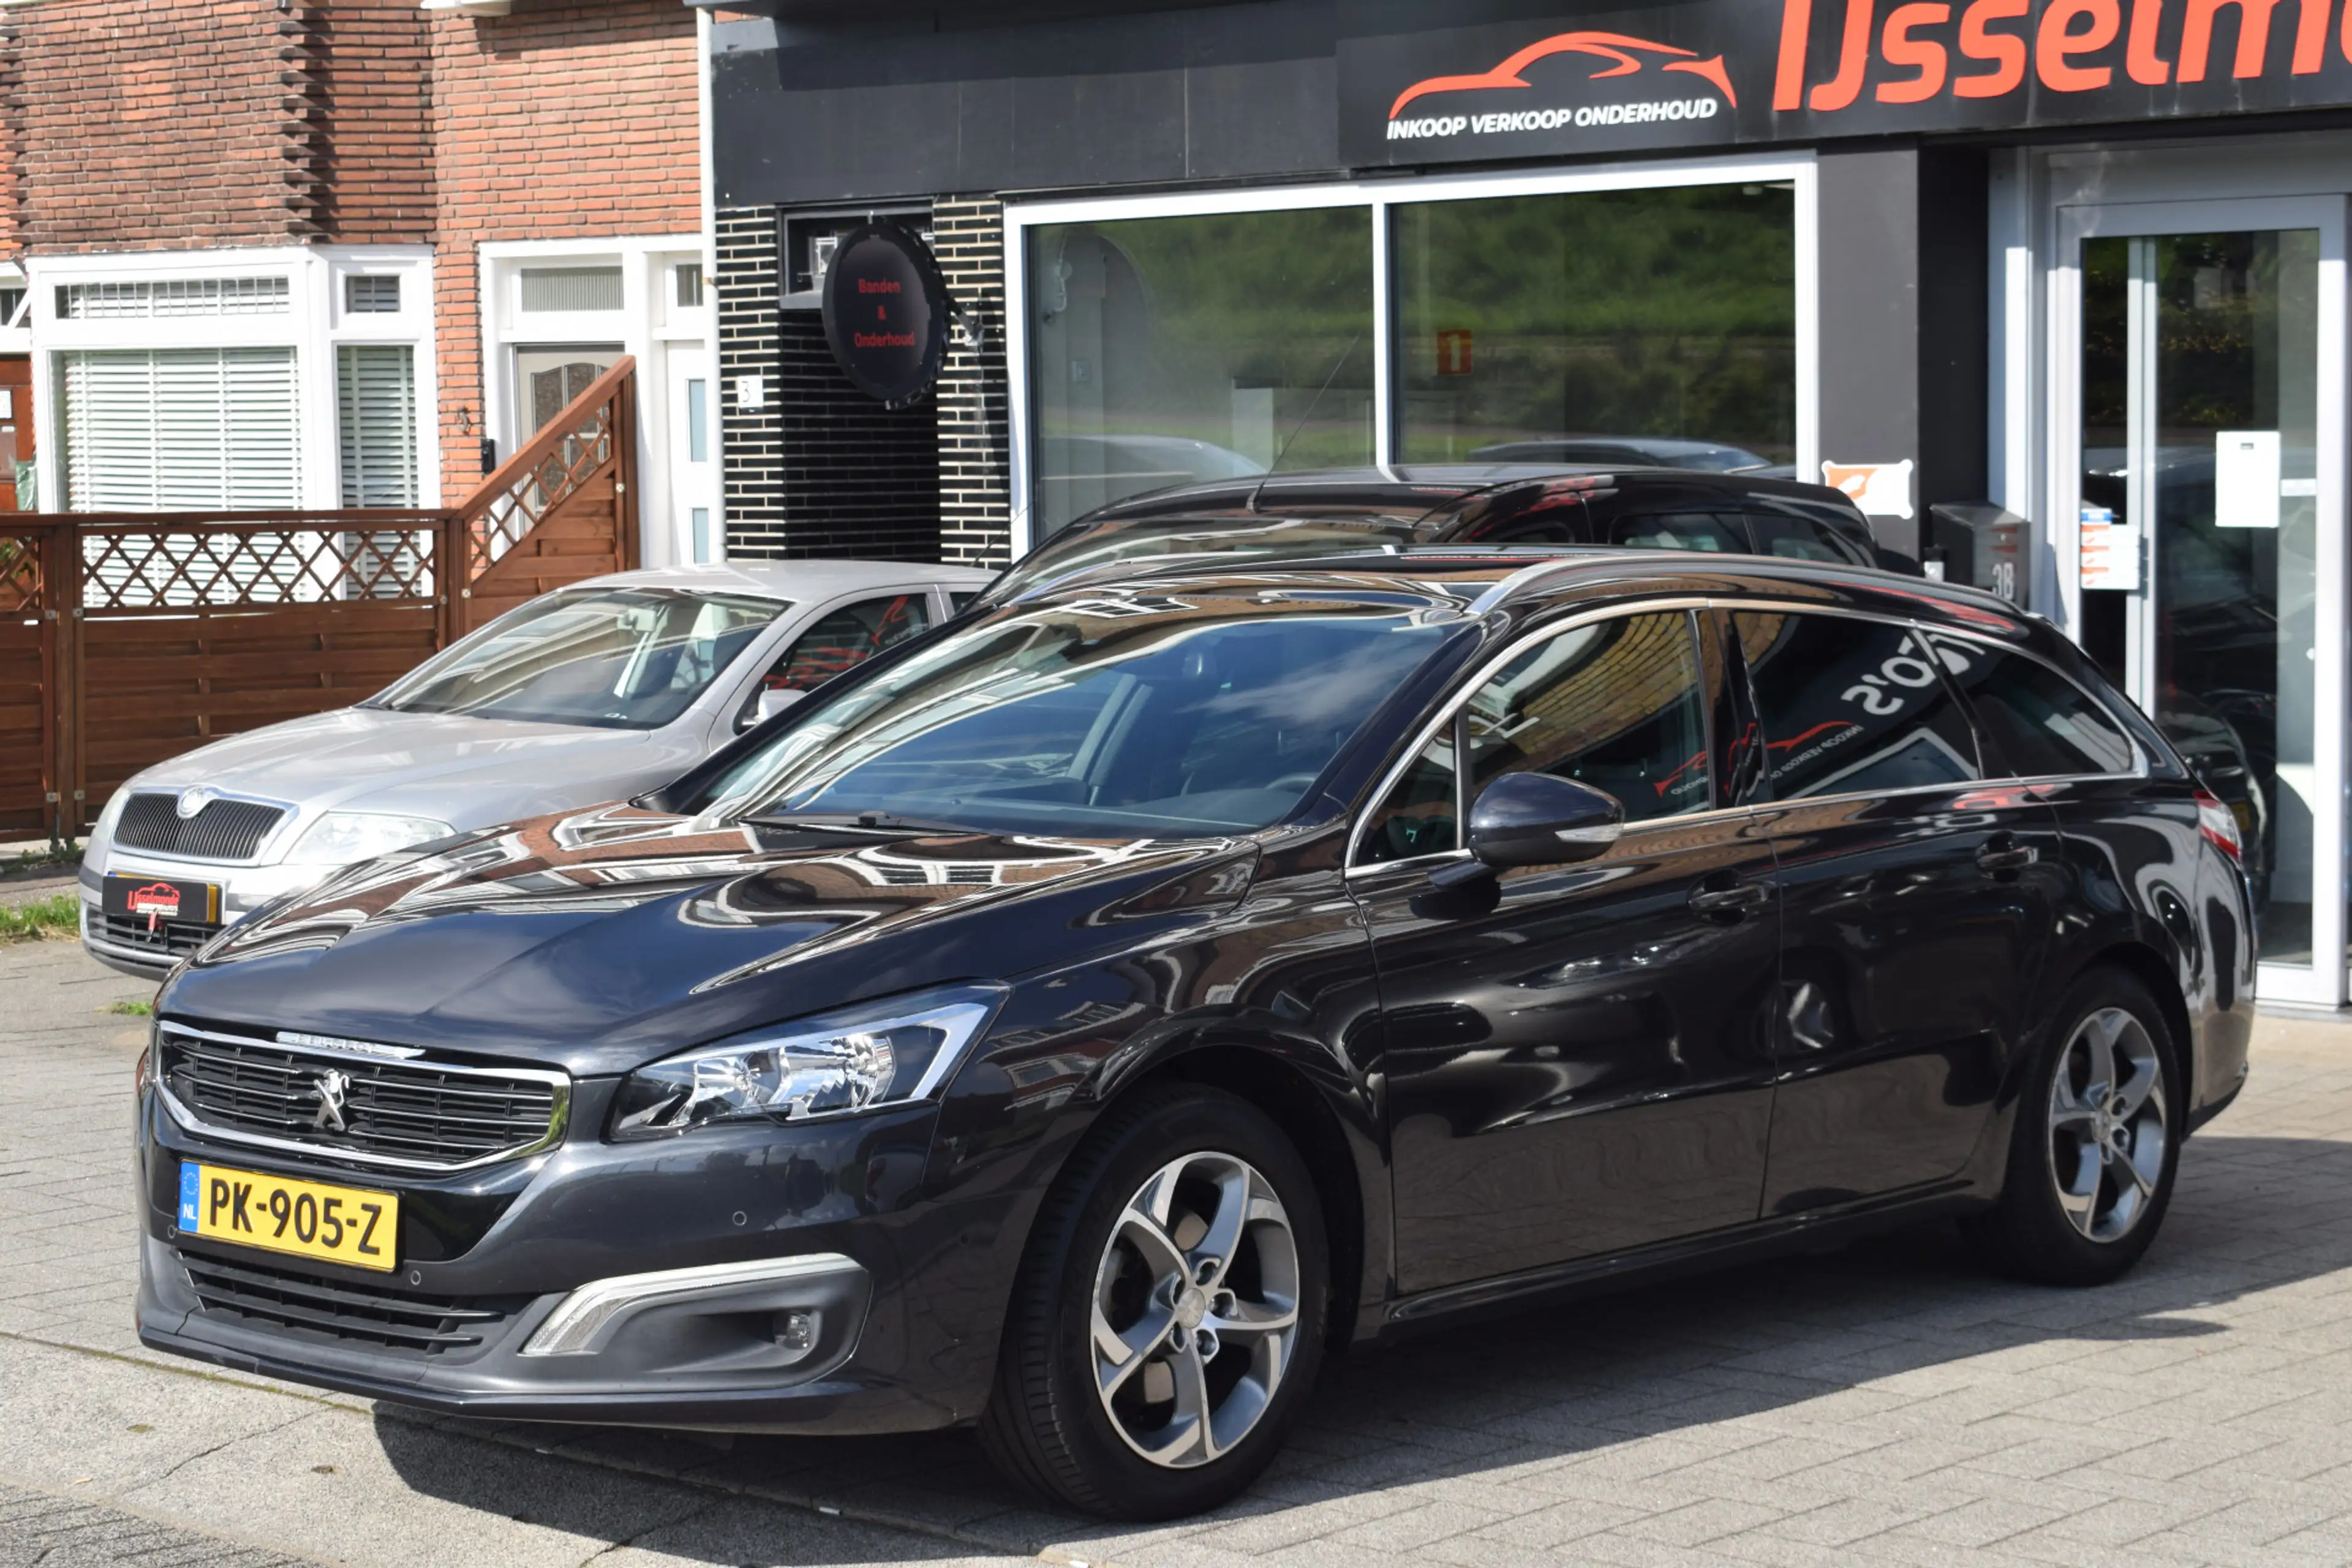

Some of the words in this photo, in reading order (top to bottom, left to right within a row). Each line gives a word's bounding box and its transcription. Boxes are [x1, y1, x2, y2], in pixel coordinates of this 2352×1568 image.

[1772, 0, 2352, 111] IJsselm
[1386, 116, 1468, 140] INKOOP
[1471, 108, 1572, 134] VERKOOP
[1574, 97, 1718, 127] ONDERHOUD
[858, 278, 900, 293] Banden
[854, 331, 915, 347] Onderhoud
[184, 1203, 197, 1220] NL
[209, 1177, 383, 1256] PK-905-Z
